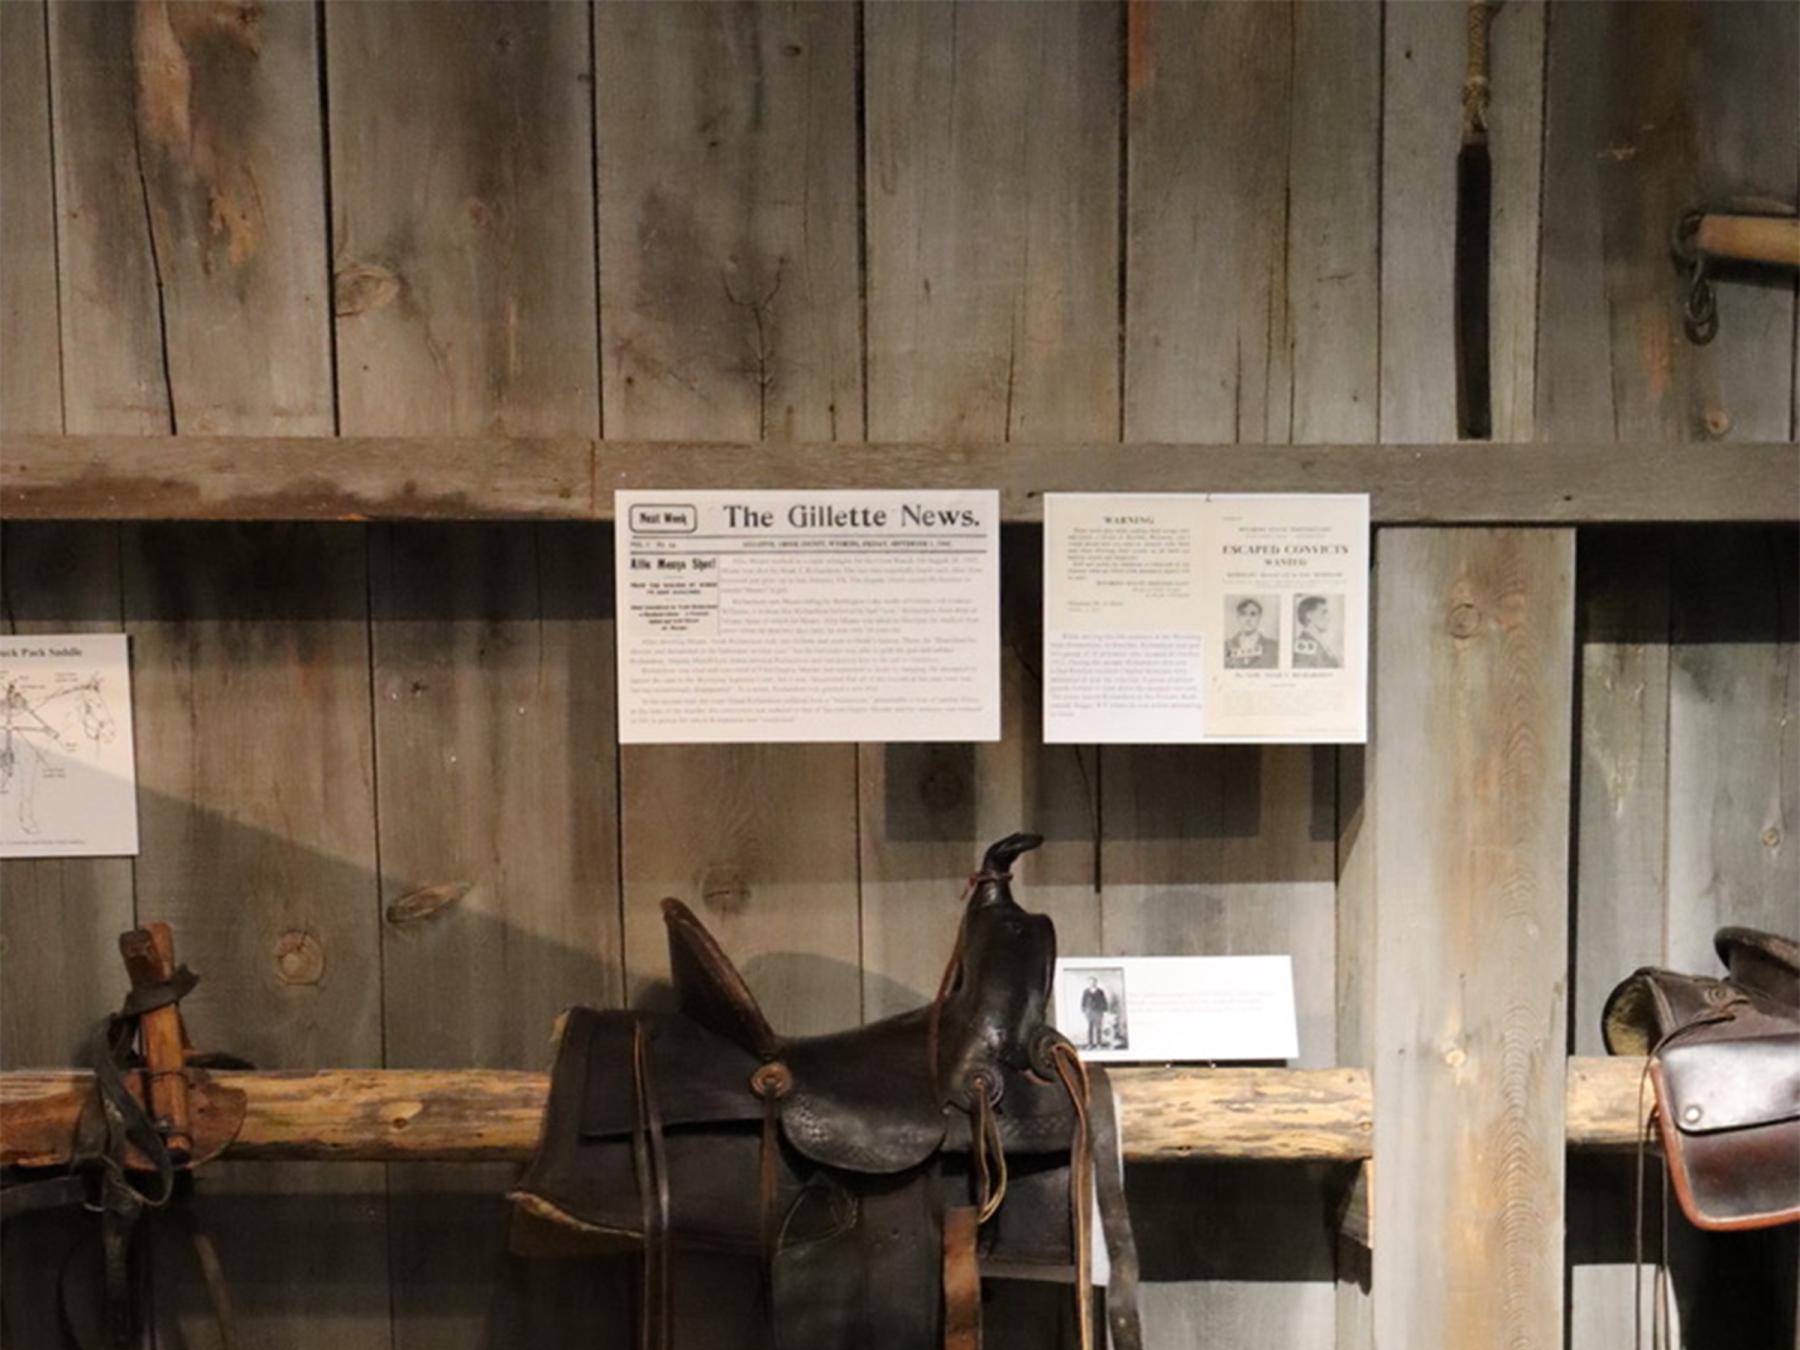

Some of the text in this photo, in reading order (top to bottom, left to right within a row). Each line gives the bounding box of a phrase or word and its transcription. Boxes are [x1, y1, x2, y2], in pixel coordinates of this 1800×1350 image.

[723, 504, 980, 528] The Gillette News.
[1222, 544, 1348, 554] ESCAPED CONVICTS
[1264, 558, 1308, 566] WANTED
[21, 648, 46, 657] Pack
[48, 646, 83, 657] Saddle
